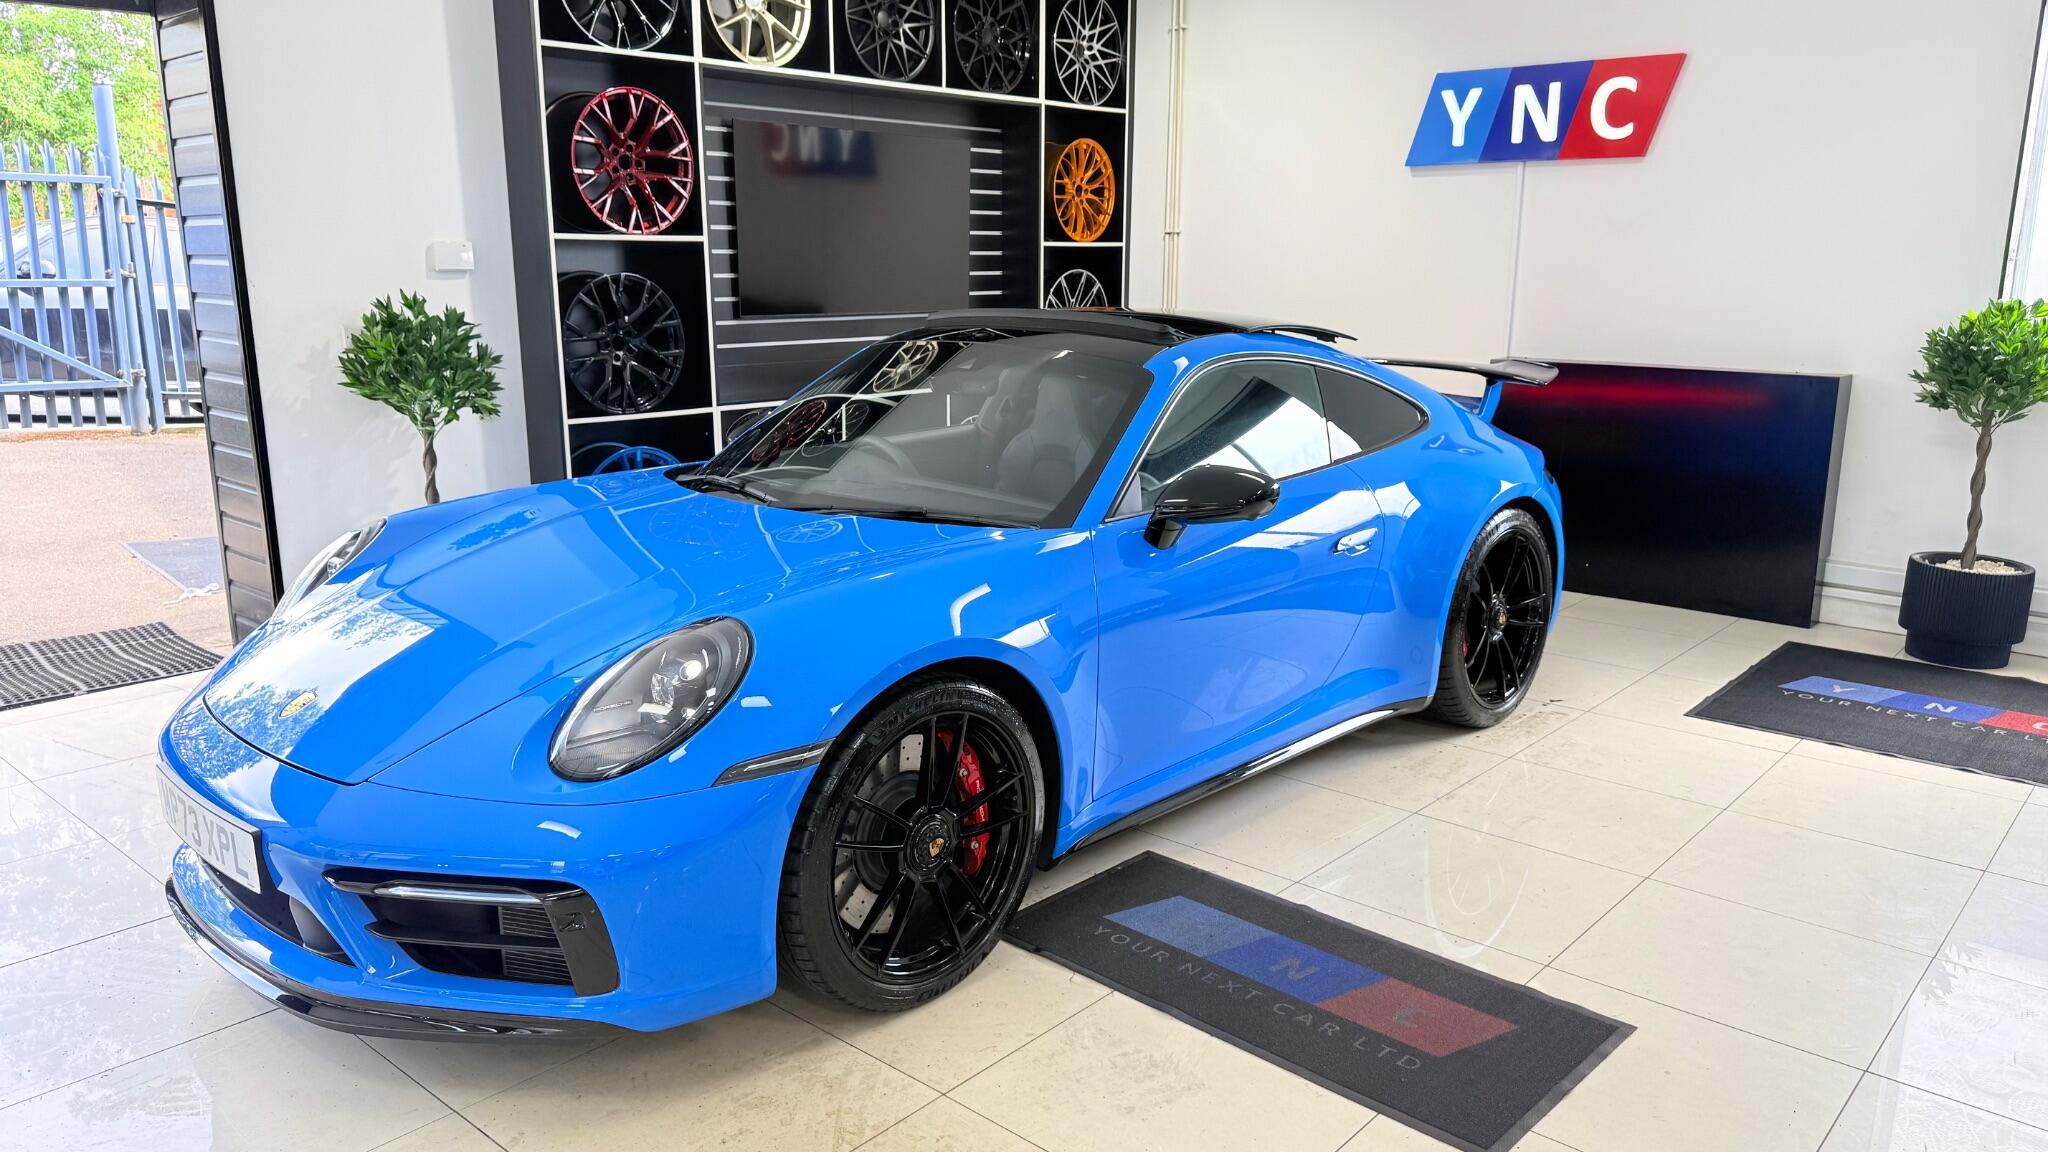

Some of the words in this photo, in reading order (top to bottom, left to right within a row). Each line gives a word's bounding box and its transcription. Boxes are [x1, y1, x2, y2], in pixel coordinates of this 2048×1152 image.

[1441, 76, 1638, 147] YNC
[1782, 690, 1851, 707] YOUR
[1865, 705, 1937, 722] NEXT
[1951, 721, 2007, 736] CAR
[202, 814, 249, 880] XPL
[1094, 925, 1169, 962] YOUR
[1179, 962, 1264, 1000] NEXT
[1272, 1003, 1340, 1036] CAR
[1353, 1036, 1421, 1069] LTD
